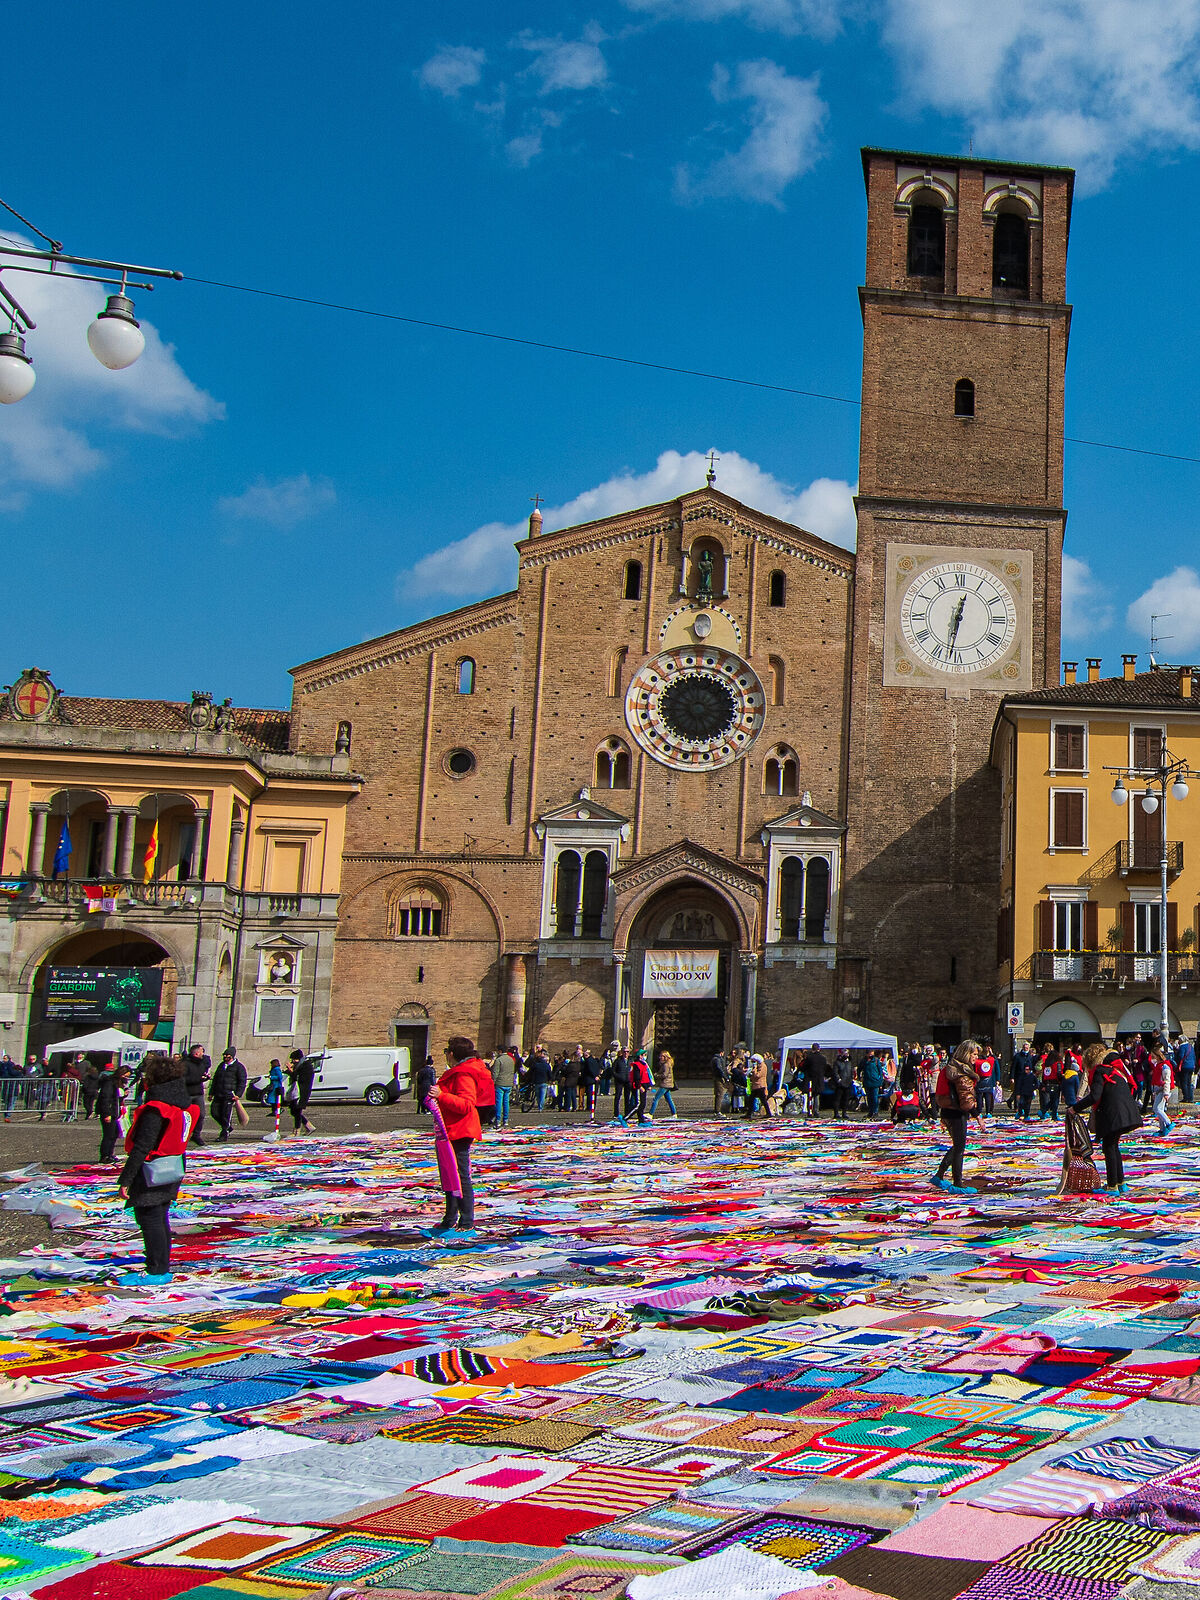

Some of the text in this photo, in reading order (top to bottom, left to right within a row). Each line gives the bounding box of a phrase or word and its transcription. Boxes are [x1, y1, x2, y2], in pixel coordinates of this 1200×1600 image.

[933, 577, 946, 591] XI
[954, 574, 966, 587] XII
[918, 592, 931, 603] X
[988, 596, 1001, 606] II
[912, 612, 925, 620] IX
[992, 616, 1006, 624] III
[954, 650, 963, 664] VI
[976, 647, 985, 660] V
[650, 964, 710, 972] Chiesa di Lodi
[650, 972, 713, 980] SINODO XIV
[50, 984, 96, 992] GIARDINI
